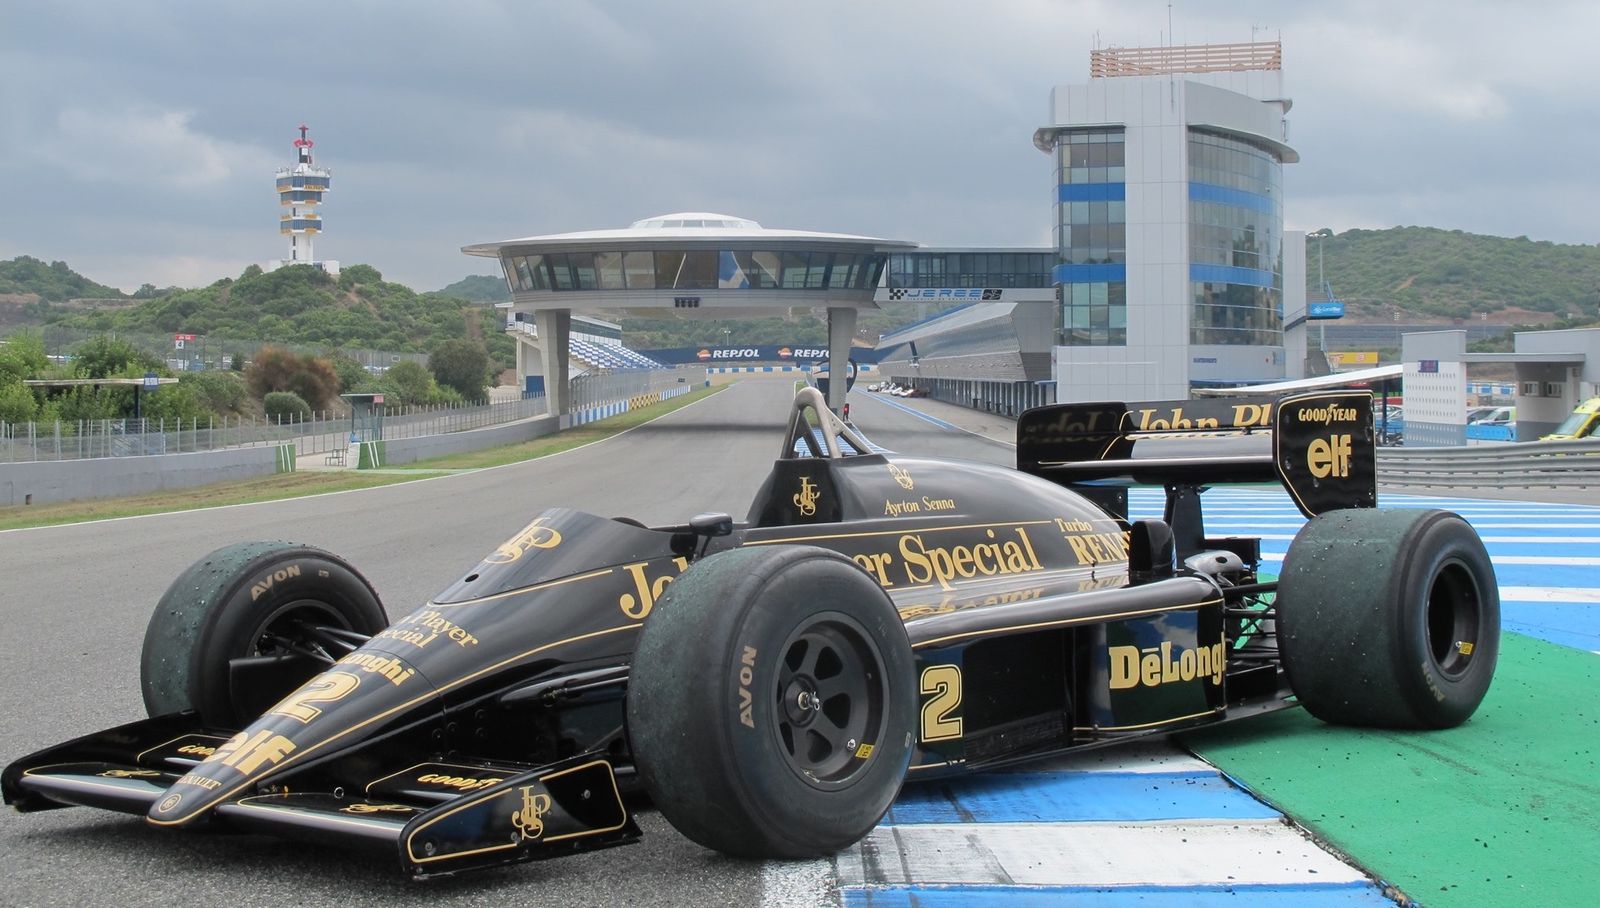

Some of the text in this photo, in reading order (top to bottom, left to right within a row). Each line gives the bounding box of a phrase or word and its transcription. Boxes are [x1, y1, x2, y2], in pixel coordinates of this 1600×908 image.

[713, 349, 760, 358] REPSOL
[794, 349, 830, 358] REPS
[1307, 434, 1352, 478] elf
[884, 496, 956, 517] Ayrton Senna
[1054, 517, 1093, 532] Turbo
[898, 527, 1045, 591] Special
[1064, 530, 1131, 566] RENA
[250, 564, 301, 602] AVON
[268, 671, 361, 724] 2
[738, 645, 757, 729] AVON
[920, 663, 963, 743] 2
